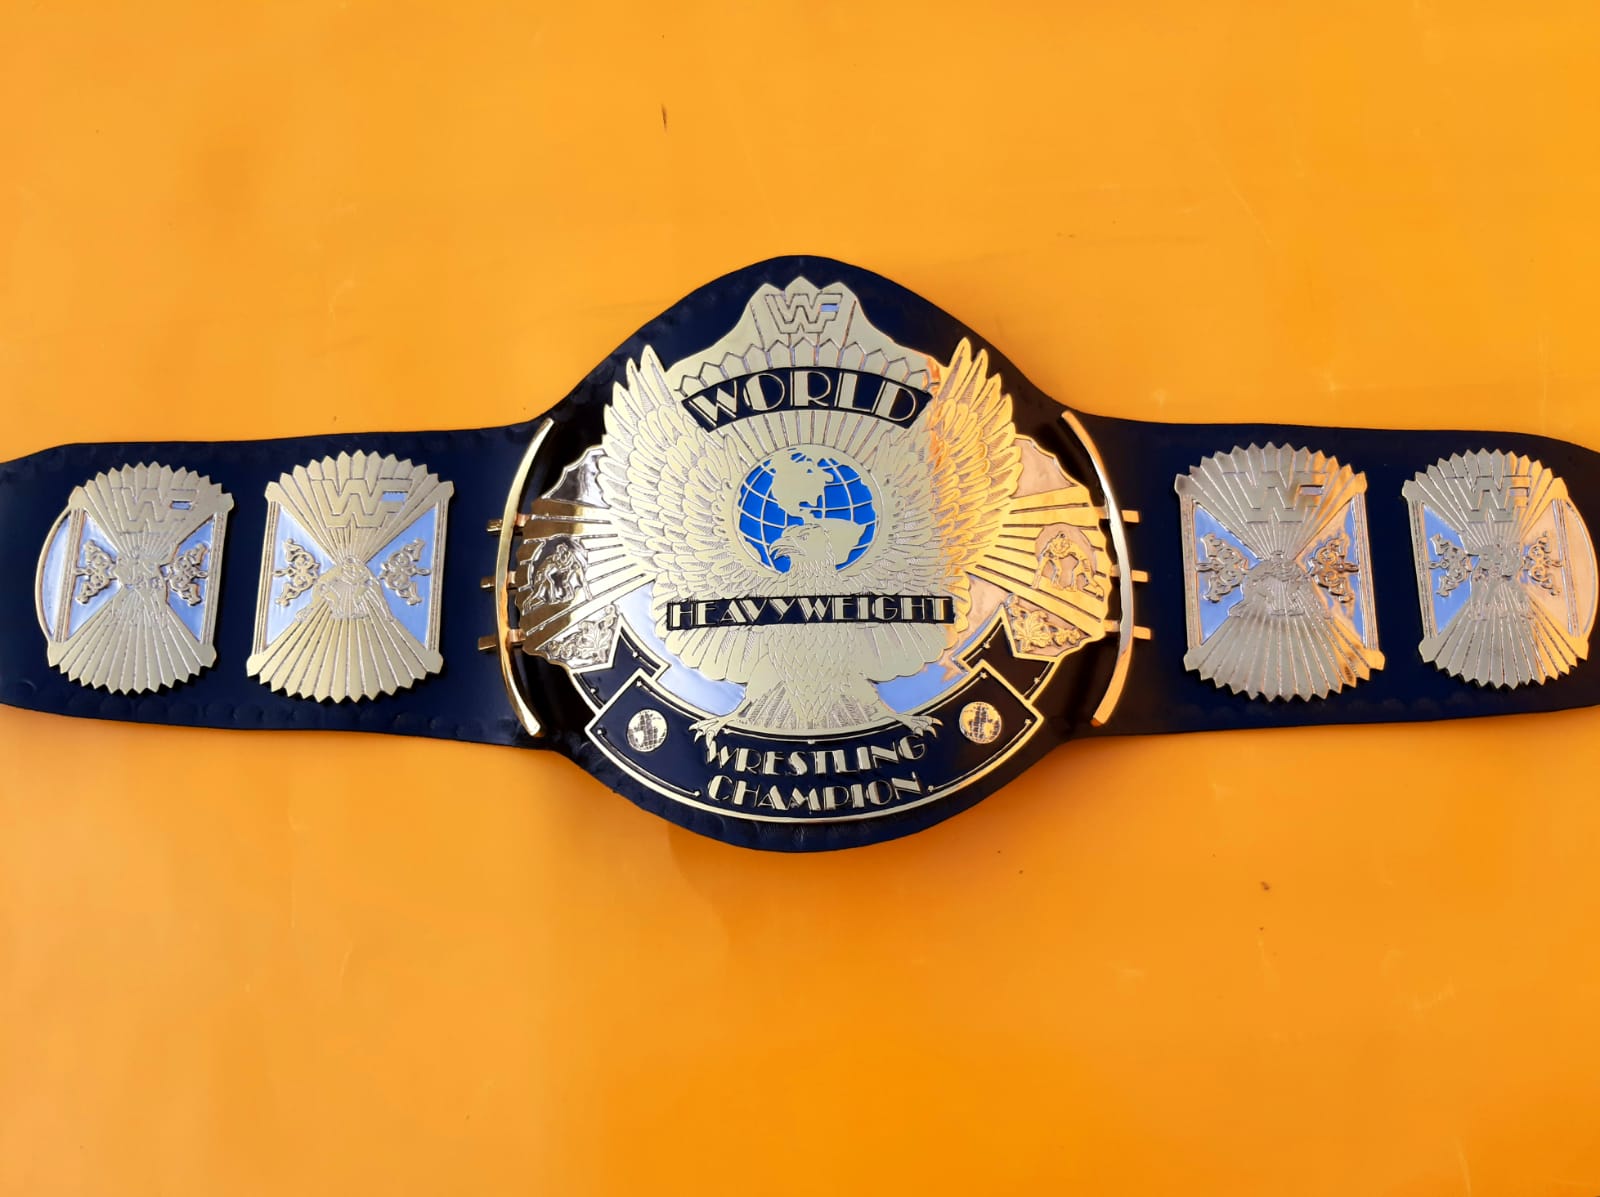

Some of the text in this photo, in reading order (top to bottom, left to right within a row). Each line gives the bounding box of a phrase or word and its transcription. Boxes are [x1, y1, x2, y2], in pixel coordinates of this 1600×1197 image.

[687, 370, 917, 428] WORLD
[669, 595, 947, 628] HEAVYWEIGHT
[705, 734, 928, 776] WRESTLING
[707, 771, 922, 811] CHAMPION
